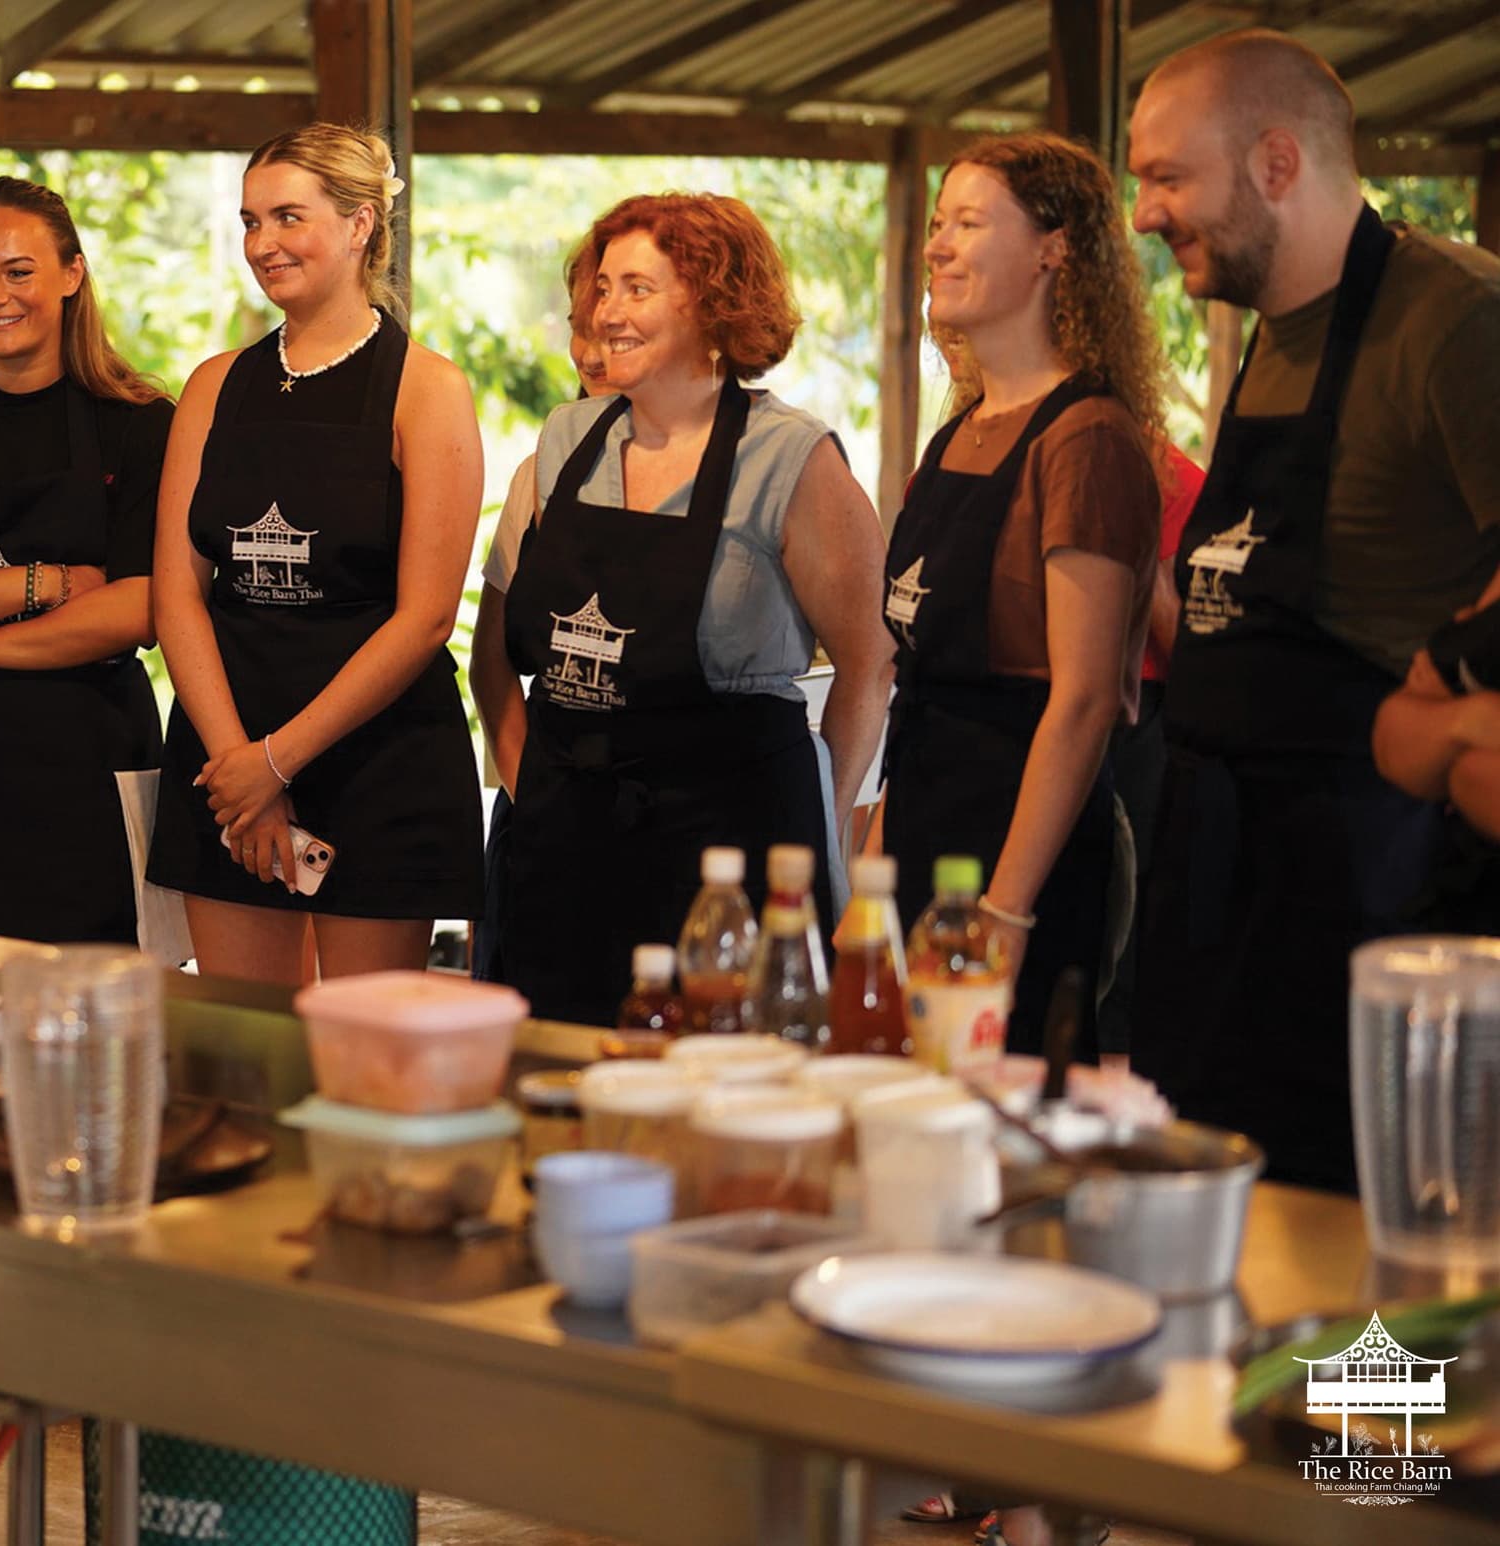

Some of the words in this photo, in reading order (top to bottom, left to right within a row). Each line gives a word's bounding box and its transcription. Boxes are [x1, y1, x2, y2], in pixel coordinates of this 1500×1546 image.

[249, 587, 270, 599] Rice
[272, 589, 297, 599] Barn
[297, 588, 324, 599] Thai
[576, 686, 600, 702] Barn
[600, 692, 626, 706] Thai
